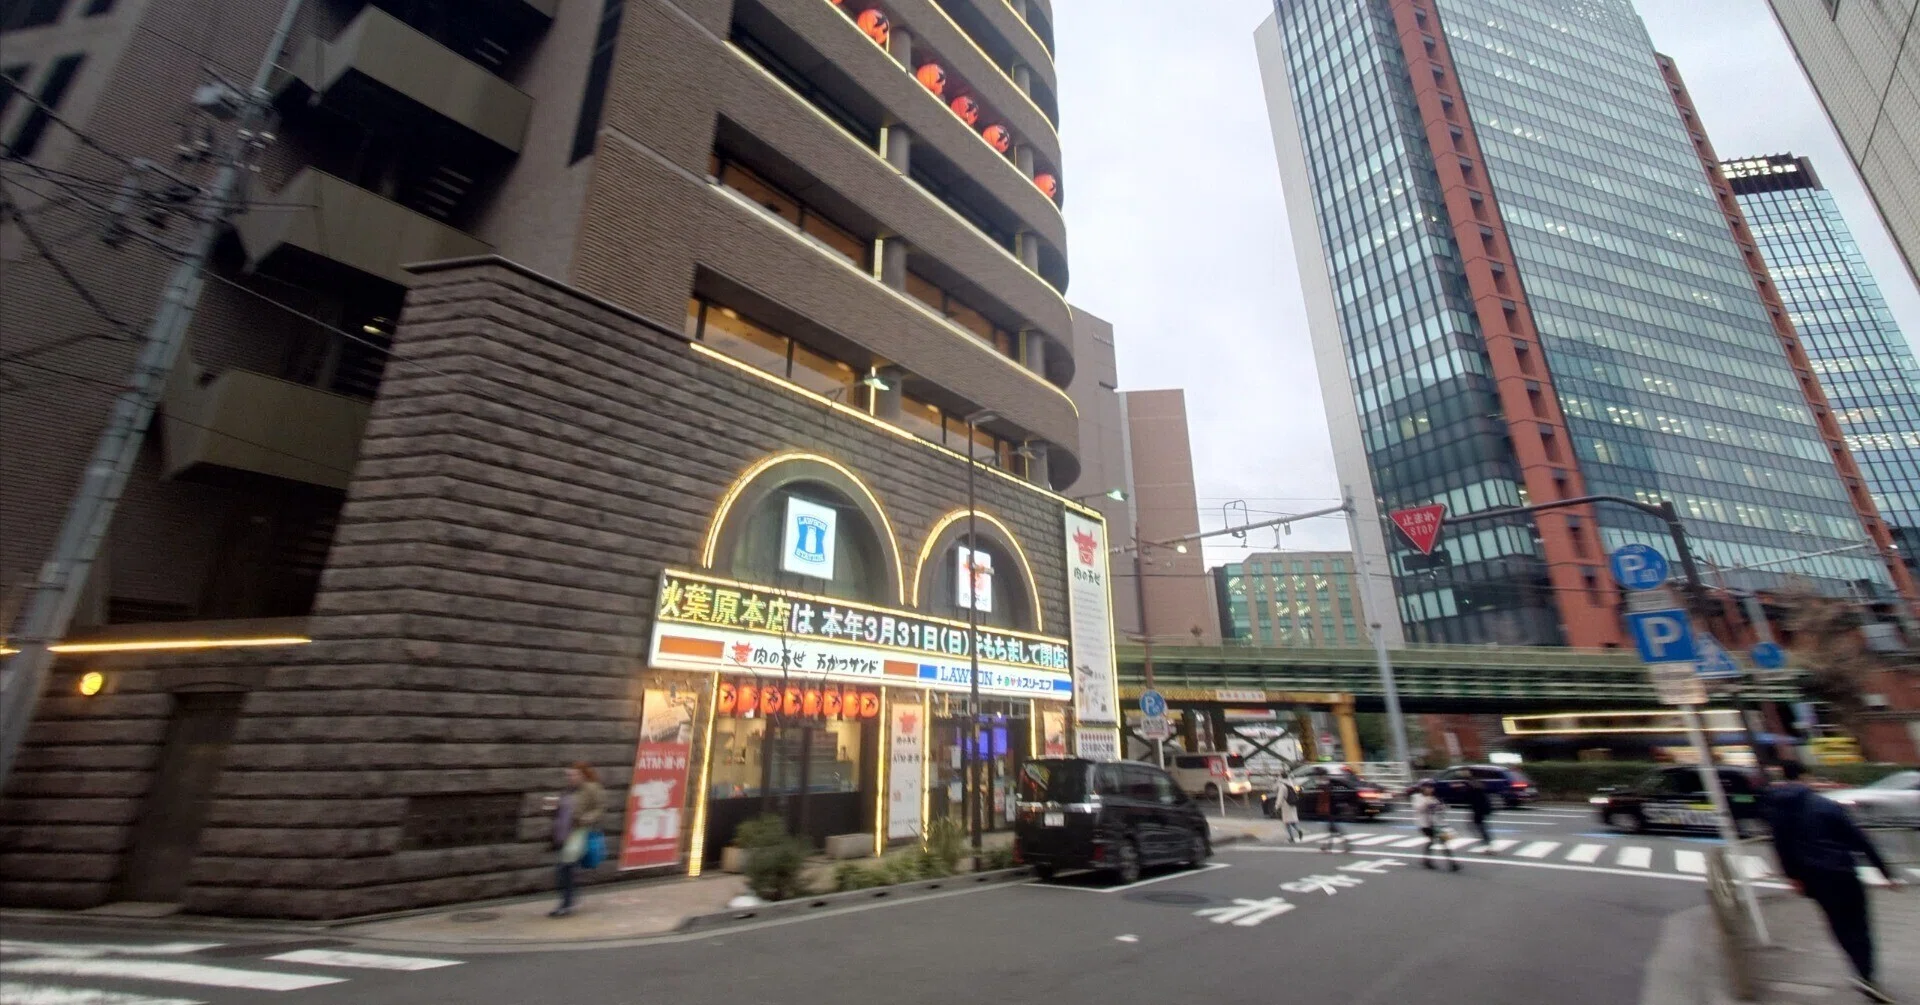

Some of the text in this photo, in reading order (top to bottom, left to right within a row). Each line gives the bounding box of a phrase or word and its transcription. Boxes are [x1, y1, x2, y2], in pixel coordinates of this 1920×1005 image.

[1403, 510, 1436, 527] 止まれ
[1410, 524, 1434, 536] STOP
[1617, 555, 1646, 584] P
[1643, 616, 1682, 657] P
[754, 647, 879, 674] 肉の万世 万かつサンド
[941, 666, 993, 686] LAWON
[1022, 677, 1052, 691] スリーエフ
